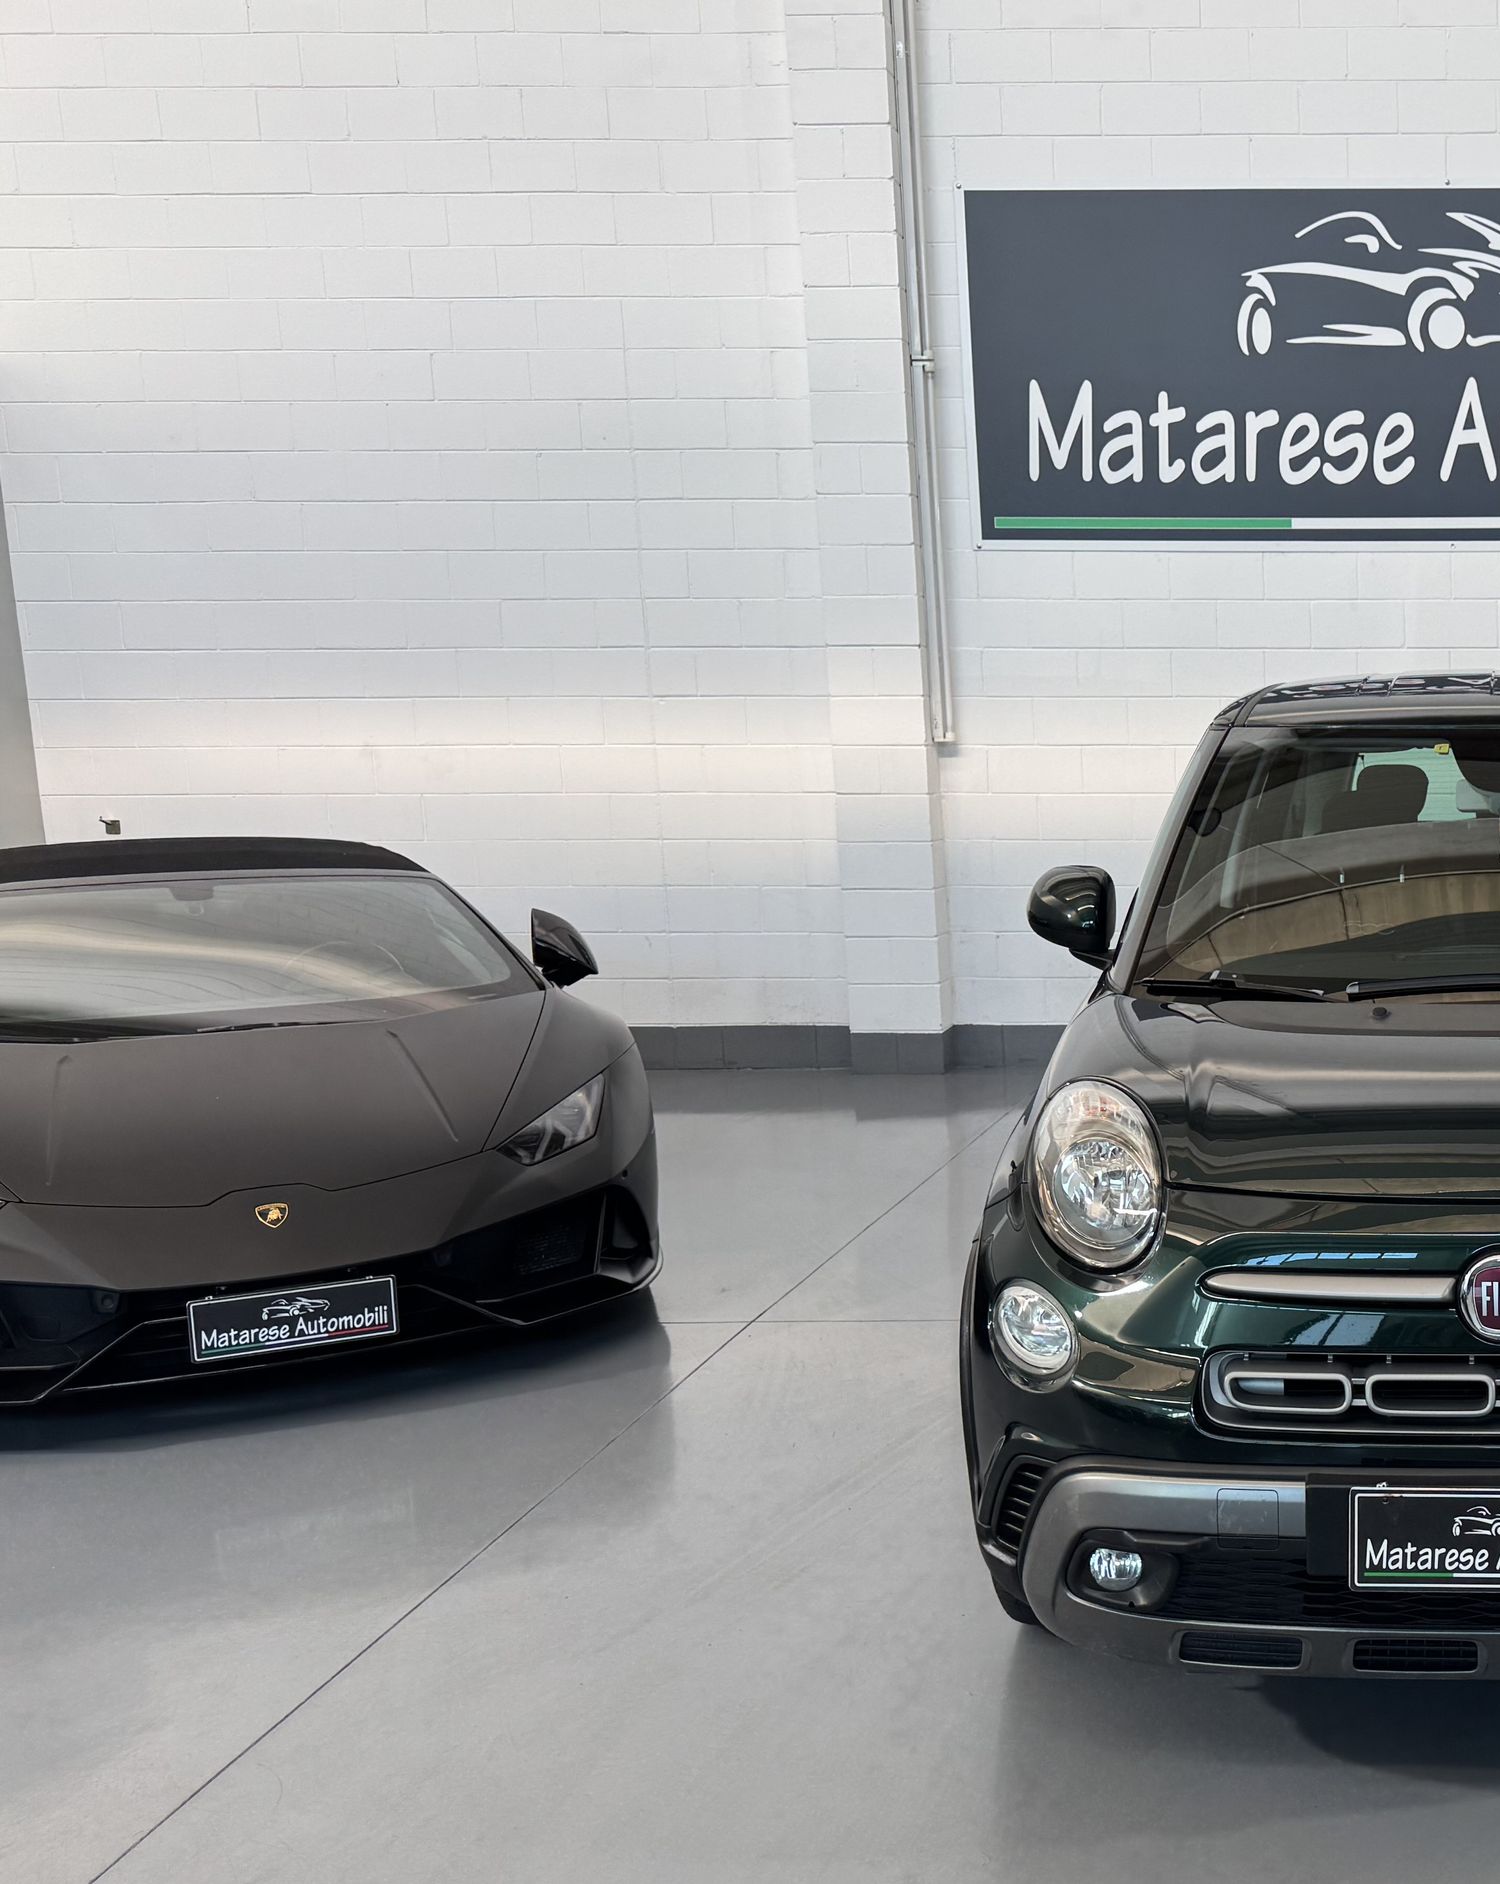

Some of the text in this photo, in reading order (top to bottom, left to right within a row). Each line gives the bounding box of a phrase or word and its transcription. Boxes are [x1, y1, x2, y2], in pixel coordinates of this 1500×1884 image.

[1028, 377, 1417, 486] Matarese
[200, 1305, 388, 1350] Matarese Automobili
[1364, 1538, 1490, 1571] Matarese
